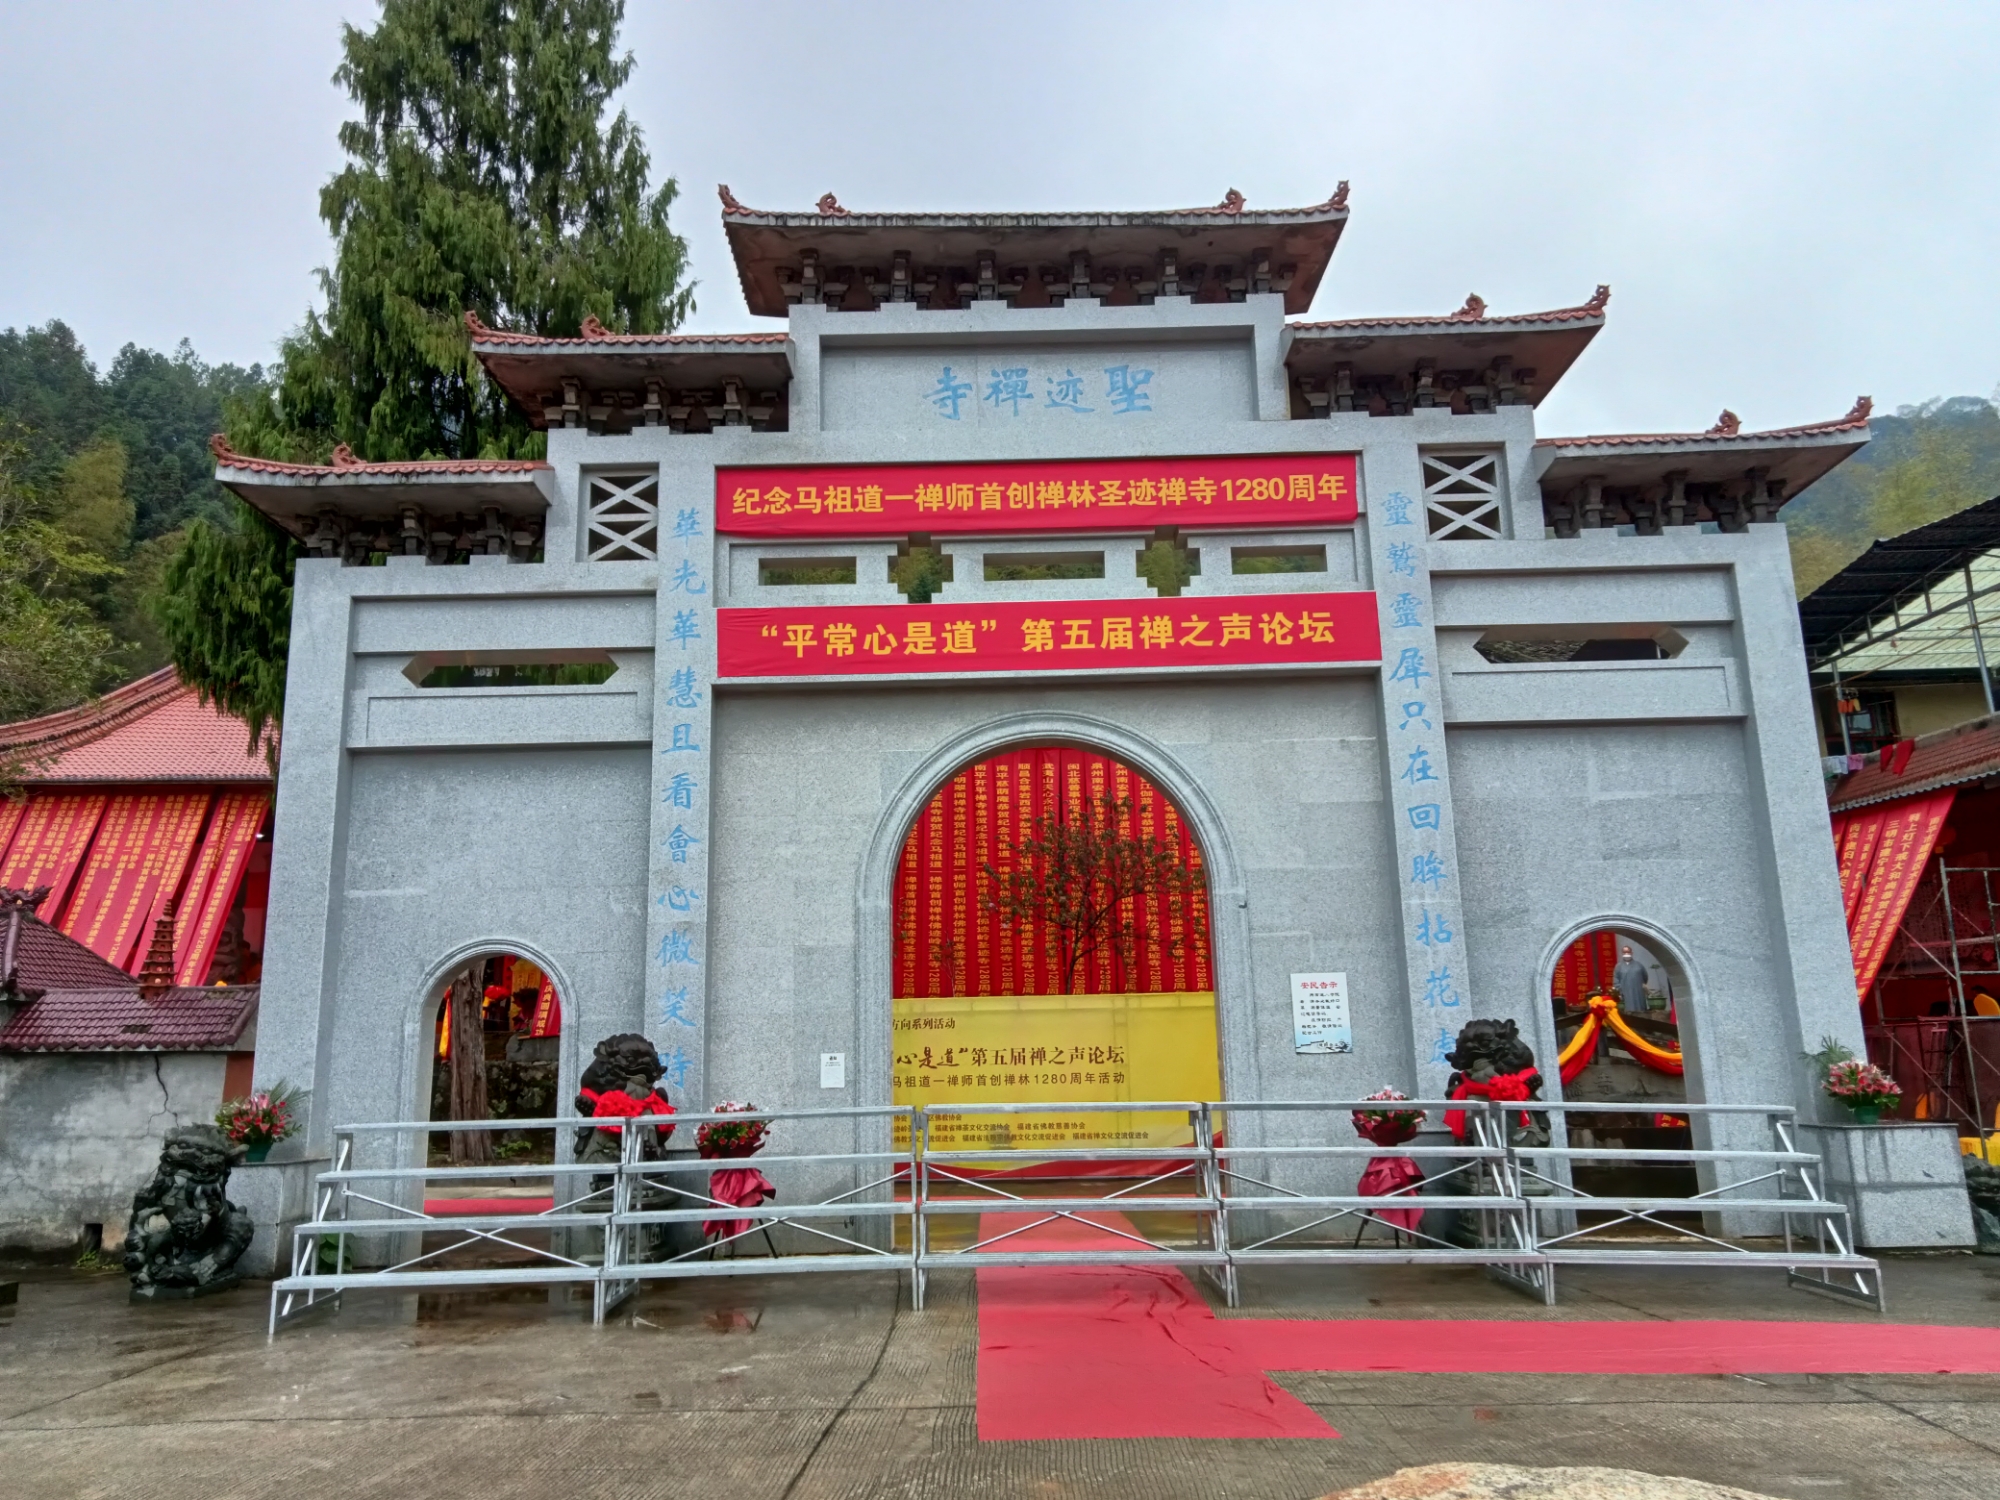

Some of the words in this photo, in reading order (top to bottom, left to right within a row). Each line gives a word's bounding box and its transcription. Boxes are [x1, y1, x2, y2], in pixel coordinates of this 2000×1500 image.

[732, 473, 1348, 516] 纪念马祖道一禅师首创禅林圣迹禅寺1280周年
[893, 1072, 1126, 1088] 马祖道一禅师首创禅林1280周年活动
